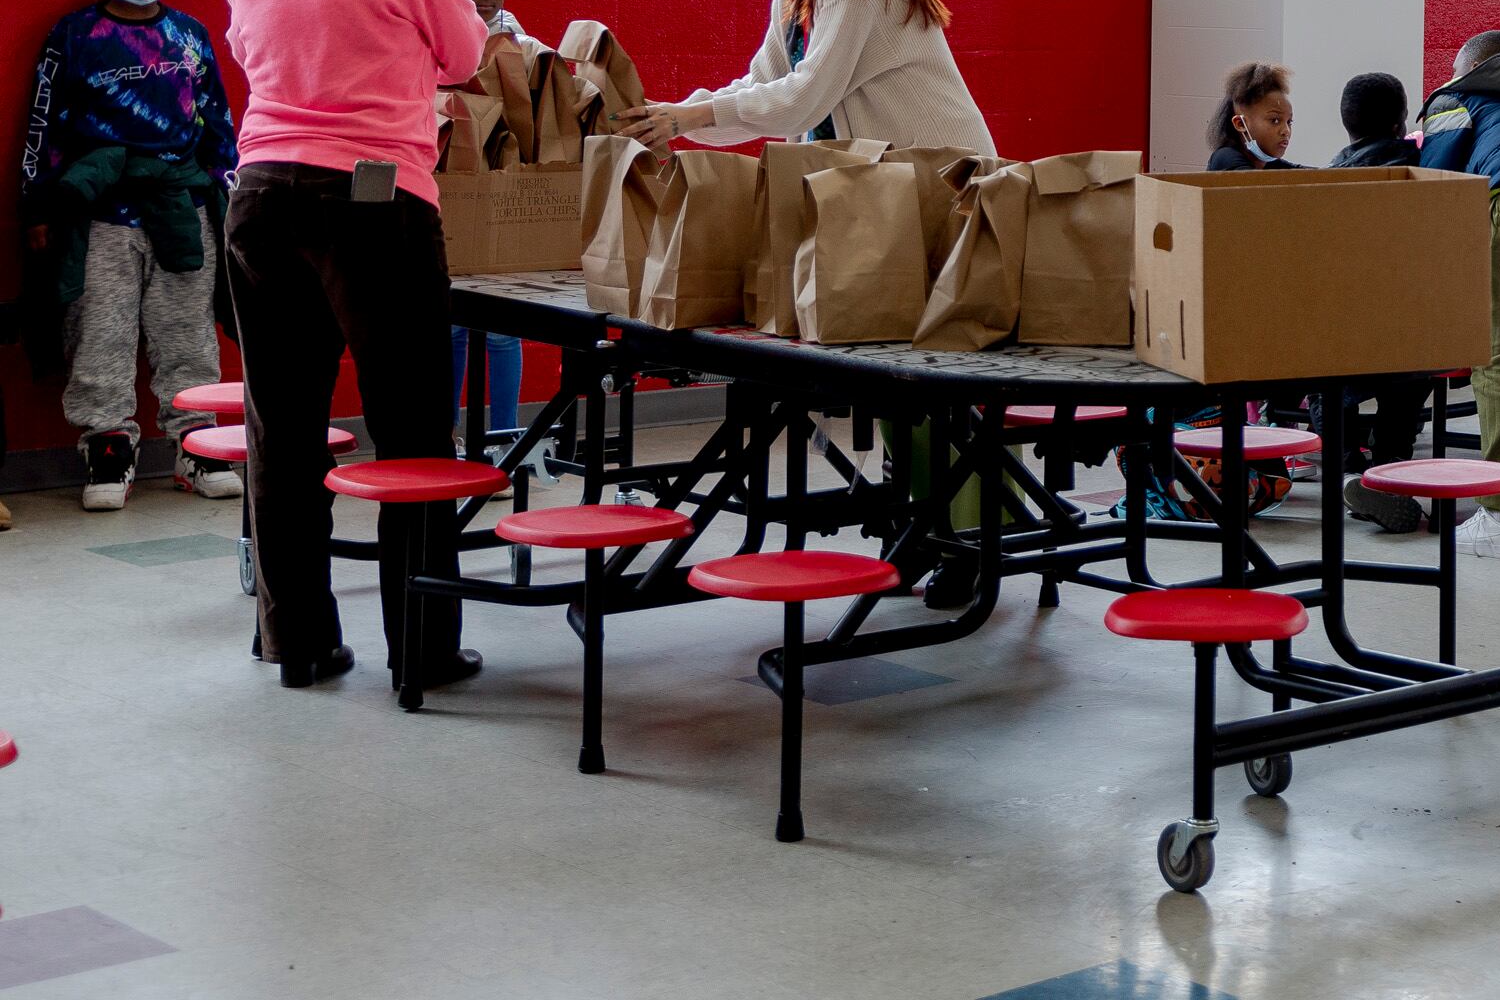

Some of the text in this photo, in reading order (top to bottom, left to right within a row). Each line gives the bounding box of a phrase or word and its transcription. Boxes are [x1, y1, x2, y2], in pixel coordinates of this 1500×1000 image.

[517, 177, 552, 185] KITCHEN
[440, 191, 458, 200] BEST
[461, 191, 475, 200] USE
[493, 194, 580, 208] WHITE TRIANGLE
[495, 206, 543, 219] TORTILLA
